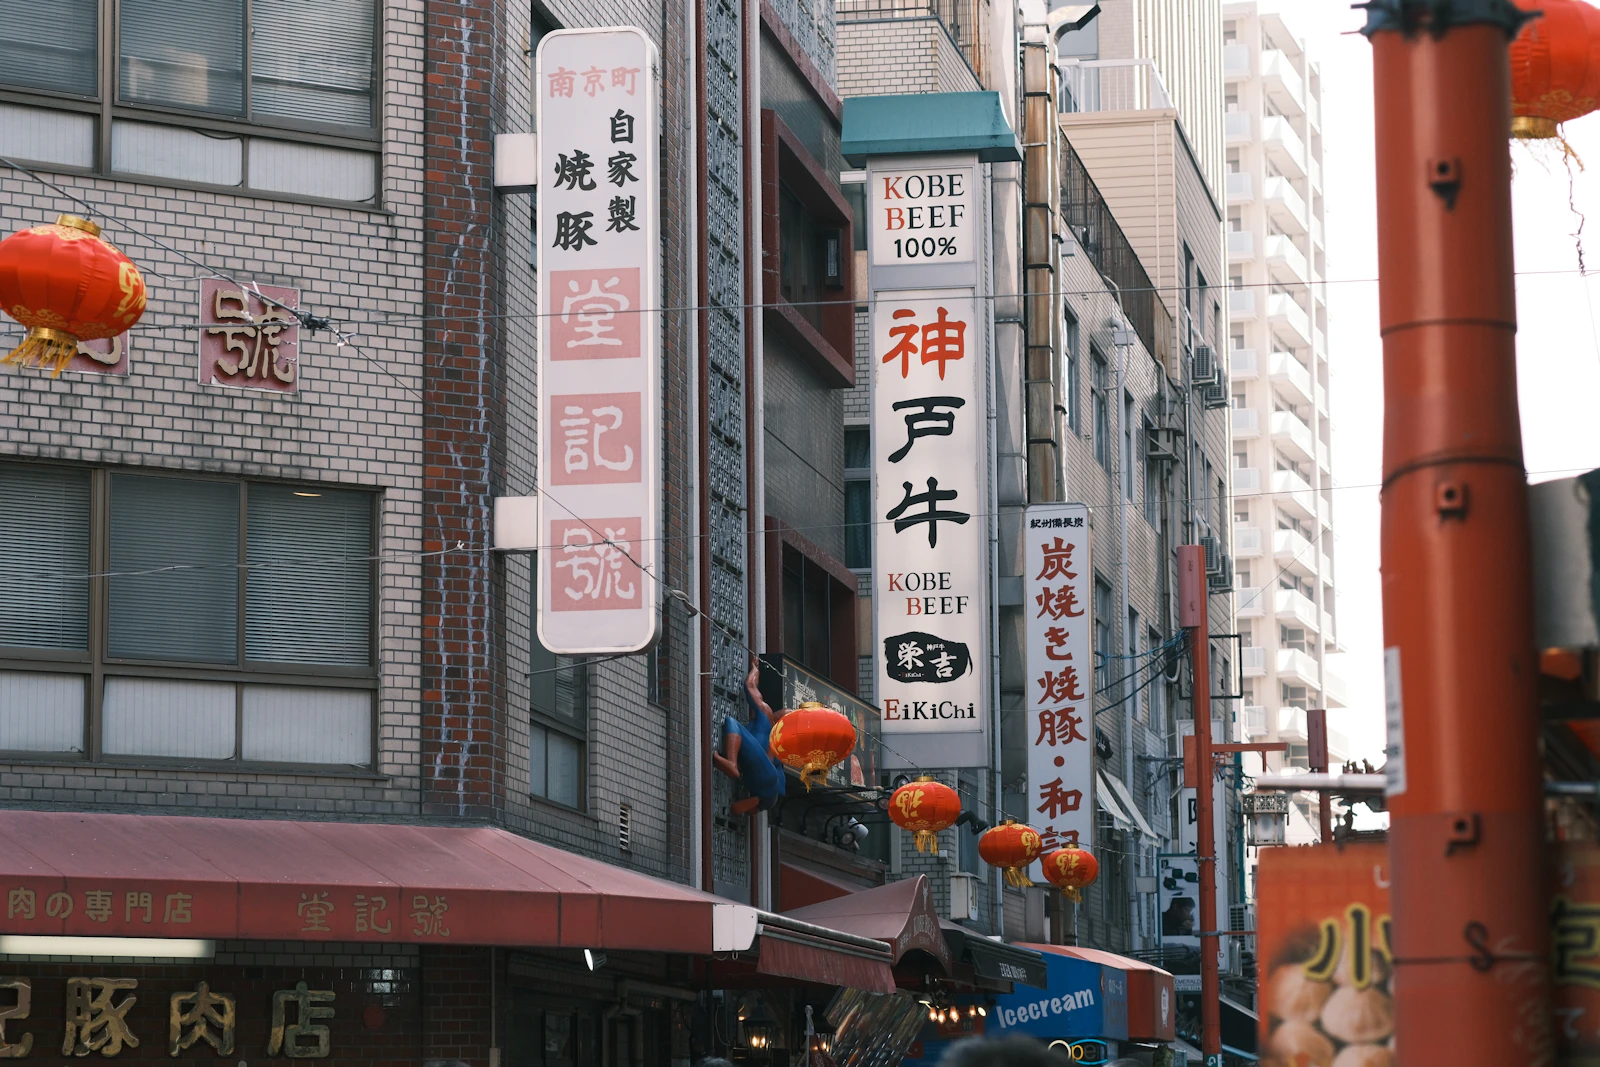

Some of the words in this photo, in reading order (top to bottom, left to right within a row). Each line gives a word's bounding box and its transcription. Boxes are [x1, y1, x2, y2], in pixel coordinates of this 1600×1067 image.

[547, 65, 641, 99] 南京町
[606, 109, 640, 233] 自家製
[552, 149, 598, 251] 焼豚
[882, 173, 965, 200] KOBE
[885, 204, 965, 231] BEEF
[894, 236, 957, 258] 100%
[882, 306, 970, 549] 神戸牛
[1030, 517, 1084, 529] 紀州備長炭
[888, 572, 952, 592] KOBE
[906, 596, 969, 616] BEEF
[884, 699, 976, 721] EiKiChi
[7, 886, 193, 924] 肉の専門店
[996, 988, 1095, 1029] Icecream
